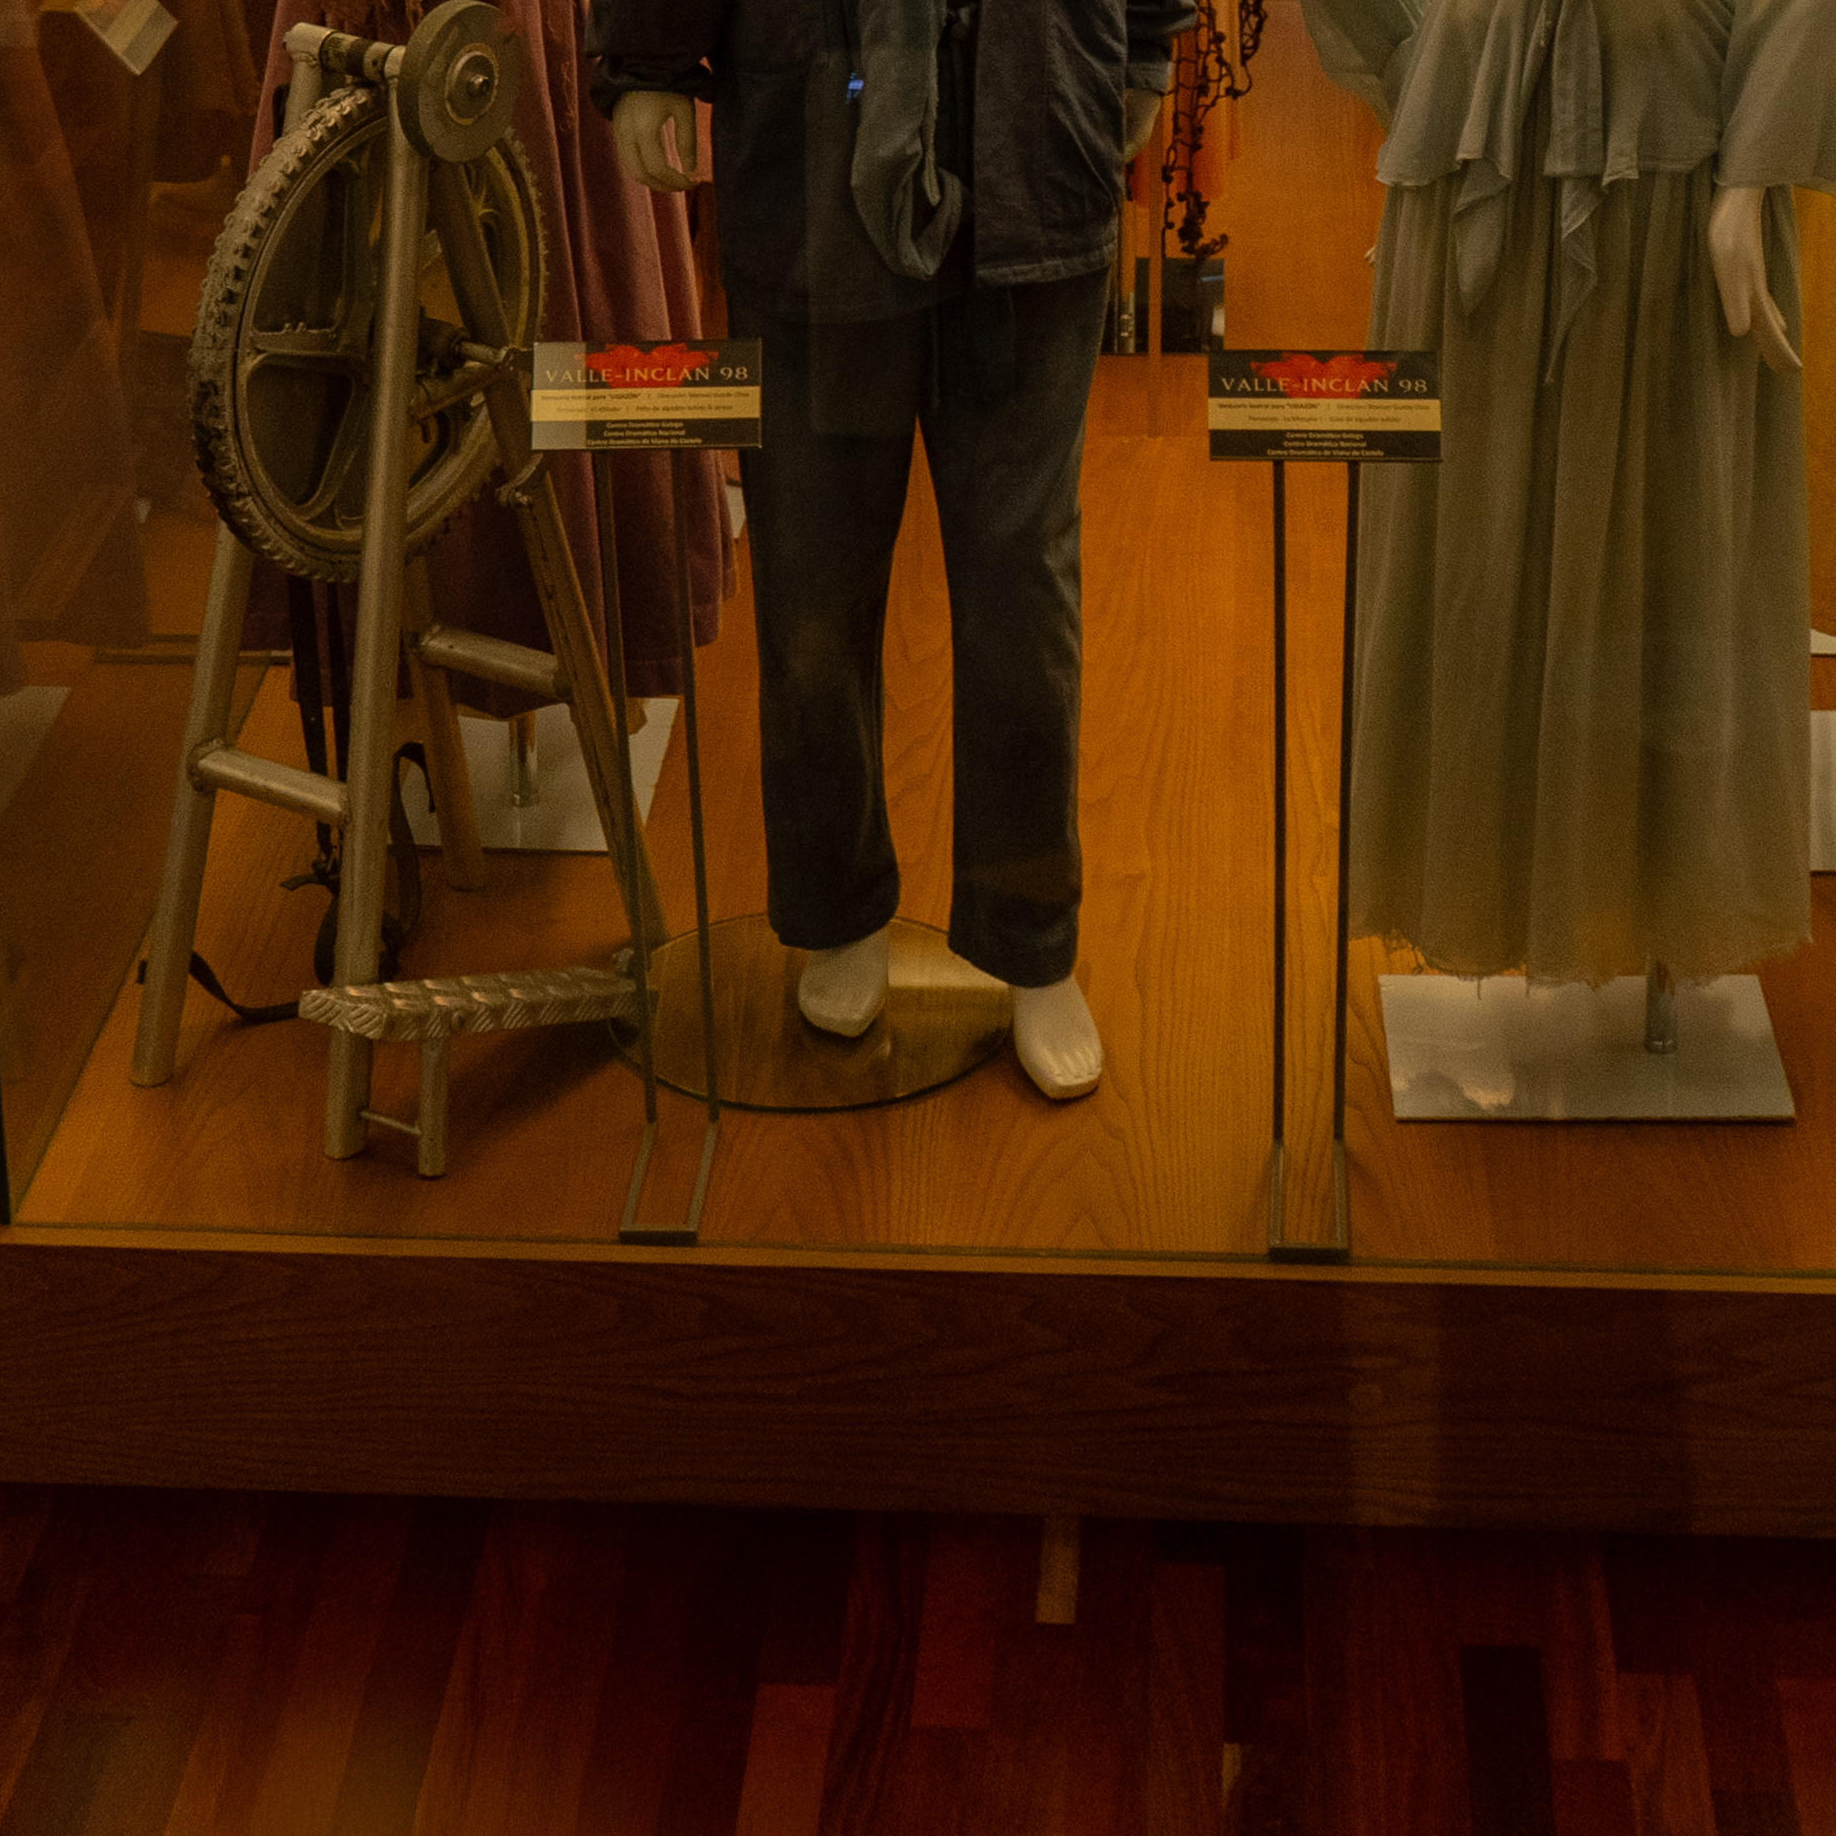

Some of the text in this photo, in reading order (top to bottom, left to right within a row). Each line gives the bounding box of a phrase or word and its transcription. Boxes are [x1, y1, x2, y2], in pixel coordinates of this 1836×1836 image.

[545, 366, 749, 383] VALLE-INCLÁN 98
[1221, 376, 1428, 394] VALLE-INCLÁN 98
